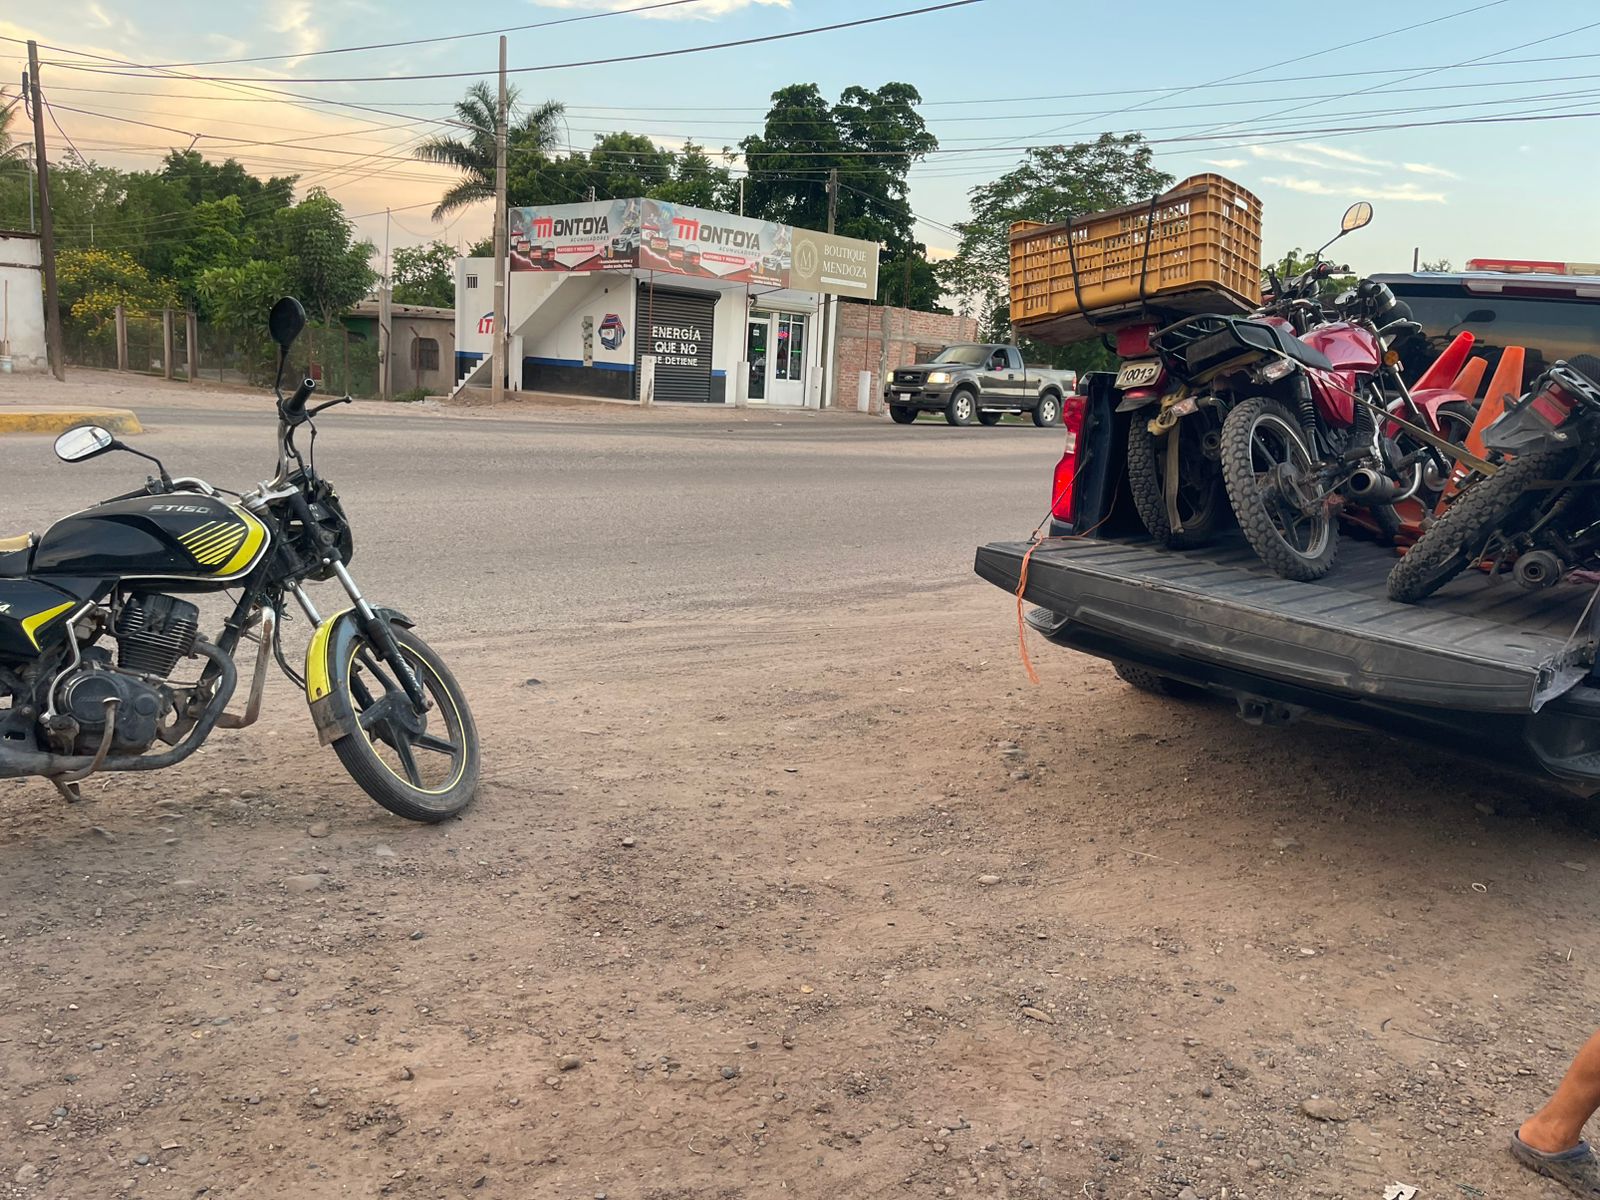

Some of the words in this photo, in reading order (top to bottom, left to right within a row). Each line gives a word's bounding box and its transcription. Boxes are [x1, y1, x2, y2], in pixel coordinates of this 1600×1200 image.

[532, 216, 609, 238] MONTOYA
[672, 216, 761, 251] MONTOYA
[570, 235, 609, 243] ACUMULADORES
[824, 245, 867, 263] BOUTIQUE
[822, 260, 867, 278] MENDOZA
[478, 318, 495, 335] LT
[652, 326, 702, 341] ENERGÍA
[655, 341, 676, 353] QUE
[680, 343, 698, 355] NO
[665, 356, 698, 367] DETIENE
[148, 504, 211, 514] FT150
